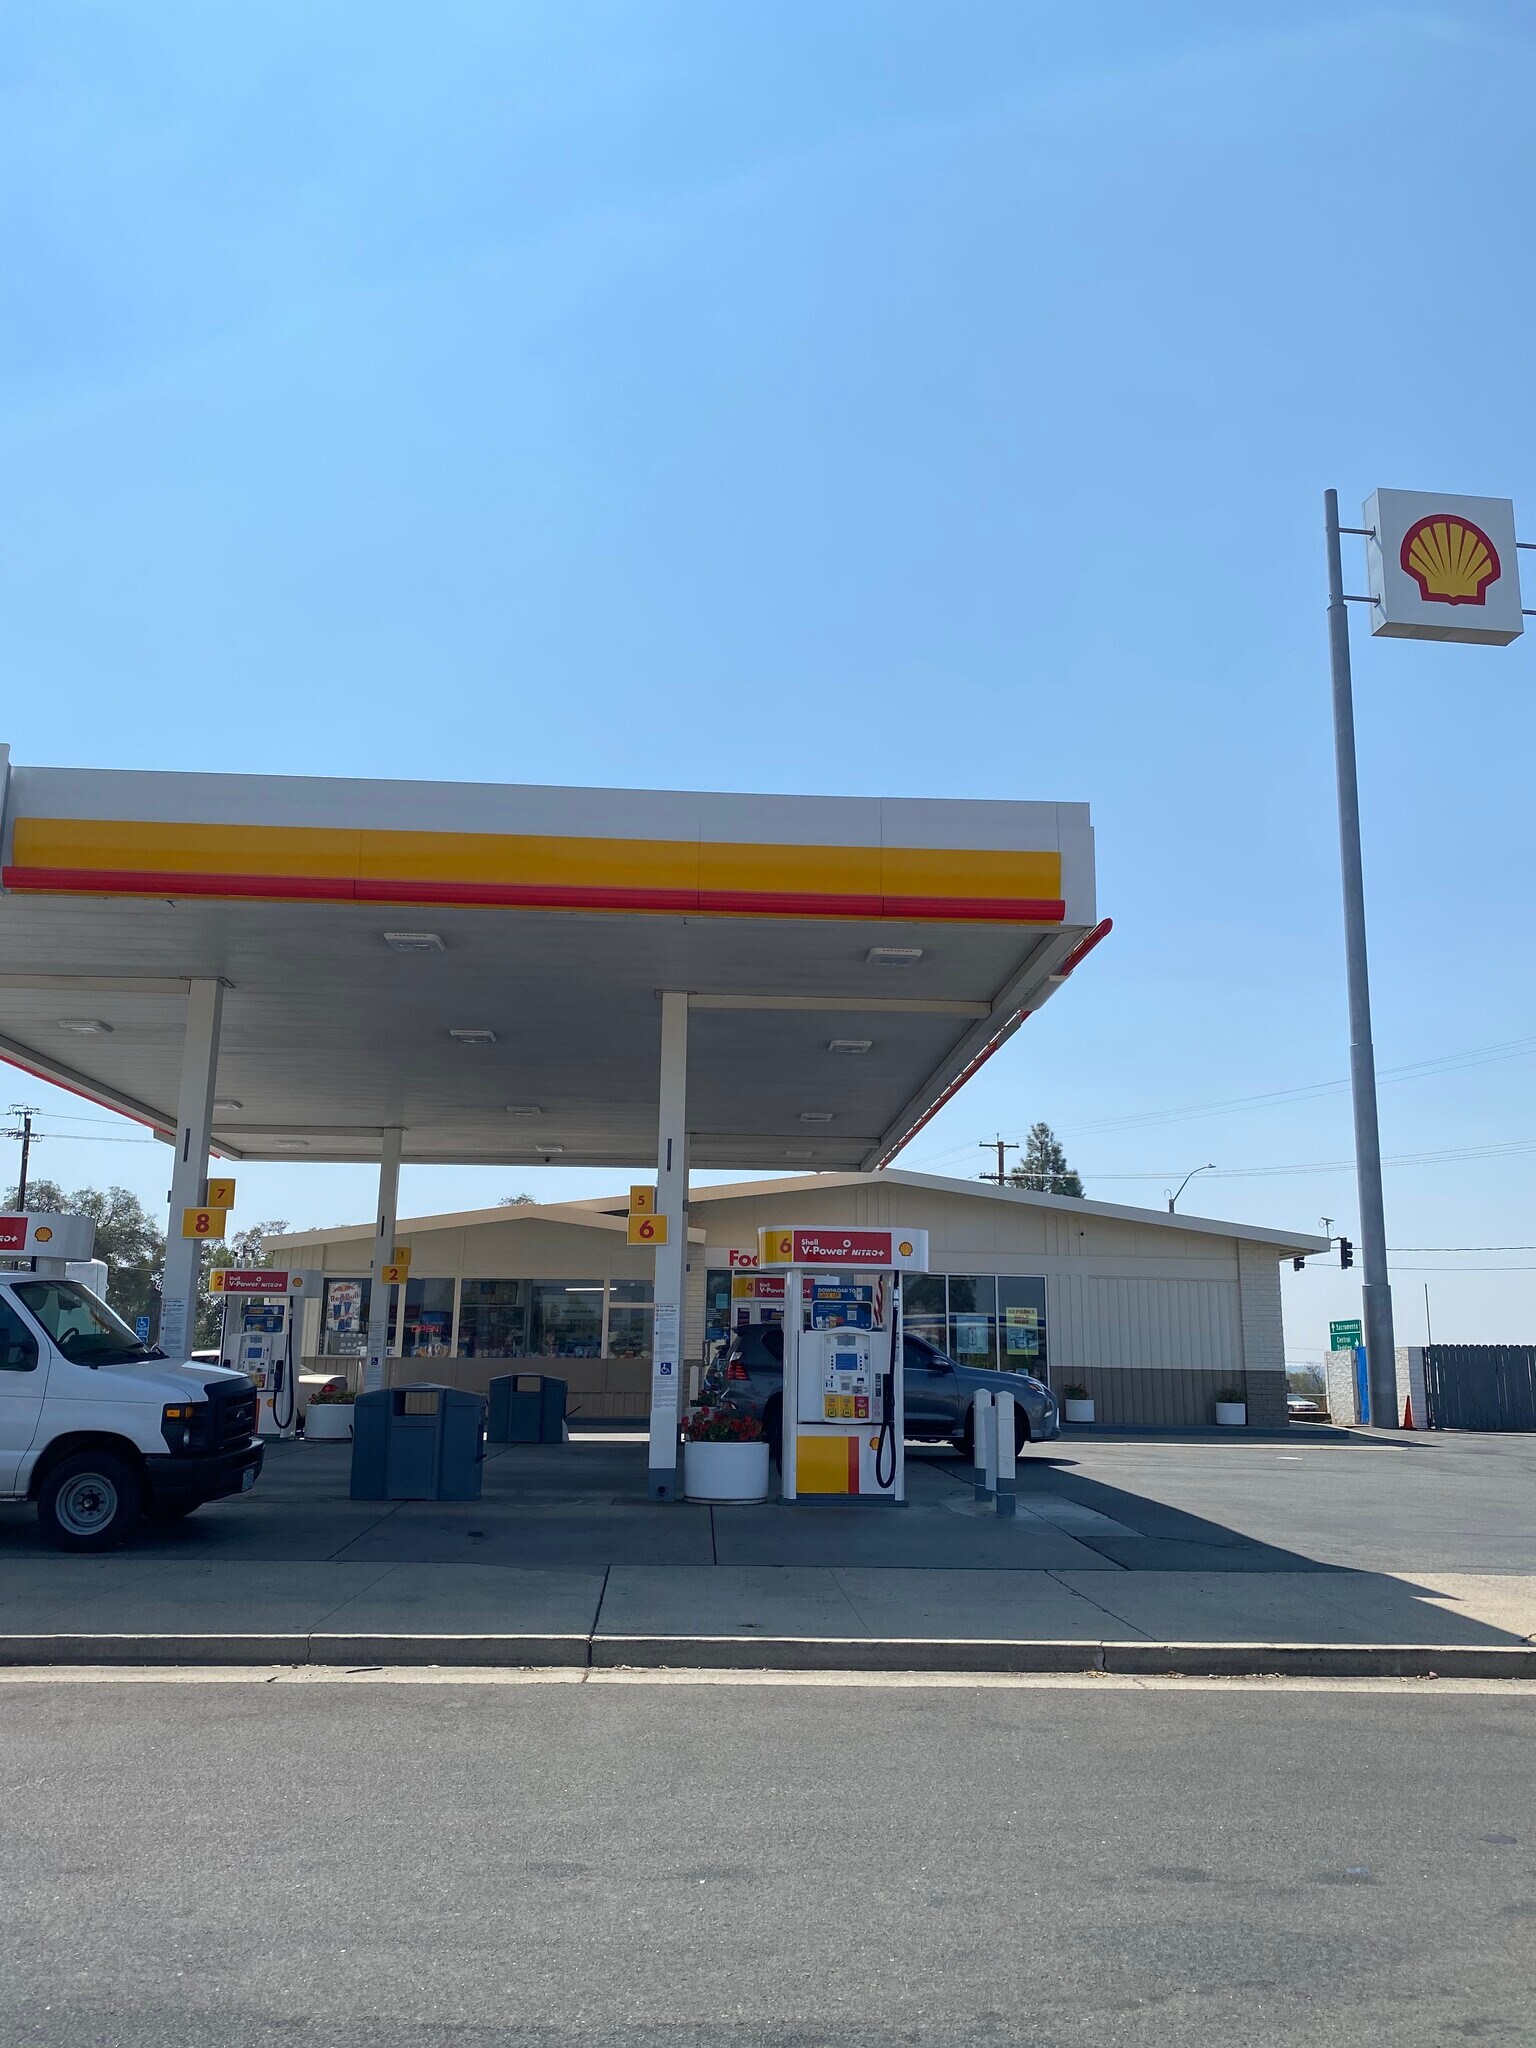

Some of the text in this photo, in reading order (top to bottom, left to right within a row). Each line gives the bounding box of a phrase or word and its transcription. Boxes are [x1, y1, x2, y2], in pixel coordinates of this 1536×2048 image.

[216, 1188, 227, 1199] 7
[637, 1195, 646, 1206] 5
[195, 1213, 210, 1233] 8
[639, 1219, 655, 1239] 6
[779, 1237, 792, 1254] 6
[801, 1238, 819, 1246] Shell
[801, 1246, 848, 1256] V-Power
[389, 1268, 399, 1281] 2
[217, 1275, 223, 1286] 2
[746, 1282, 754, 1293] 4
[330, 1292, 359, 1303] Red Bull
[411, 1325, 439, 1333] OPEN
[1336, 1323, 1359, 1331] Sacramento
[1336, 1336, 1351, 1344] Central
